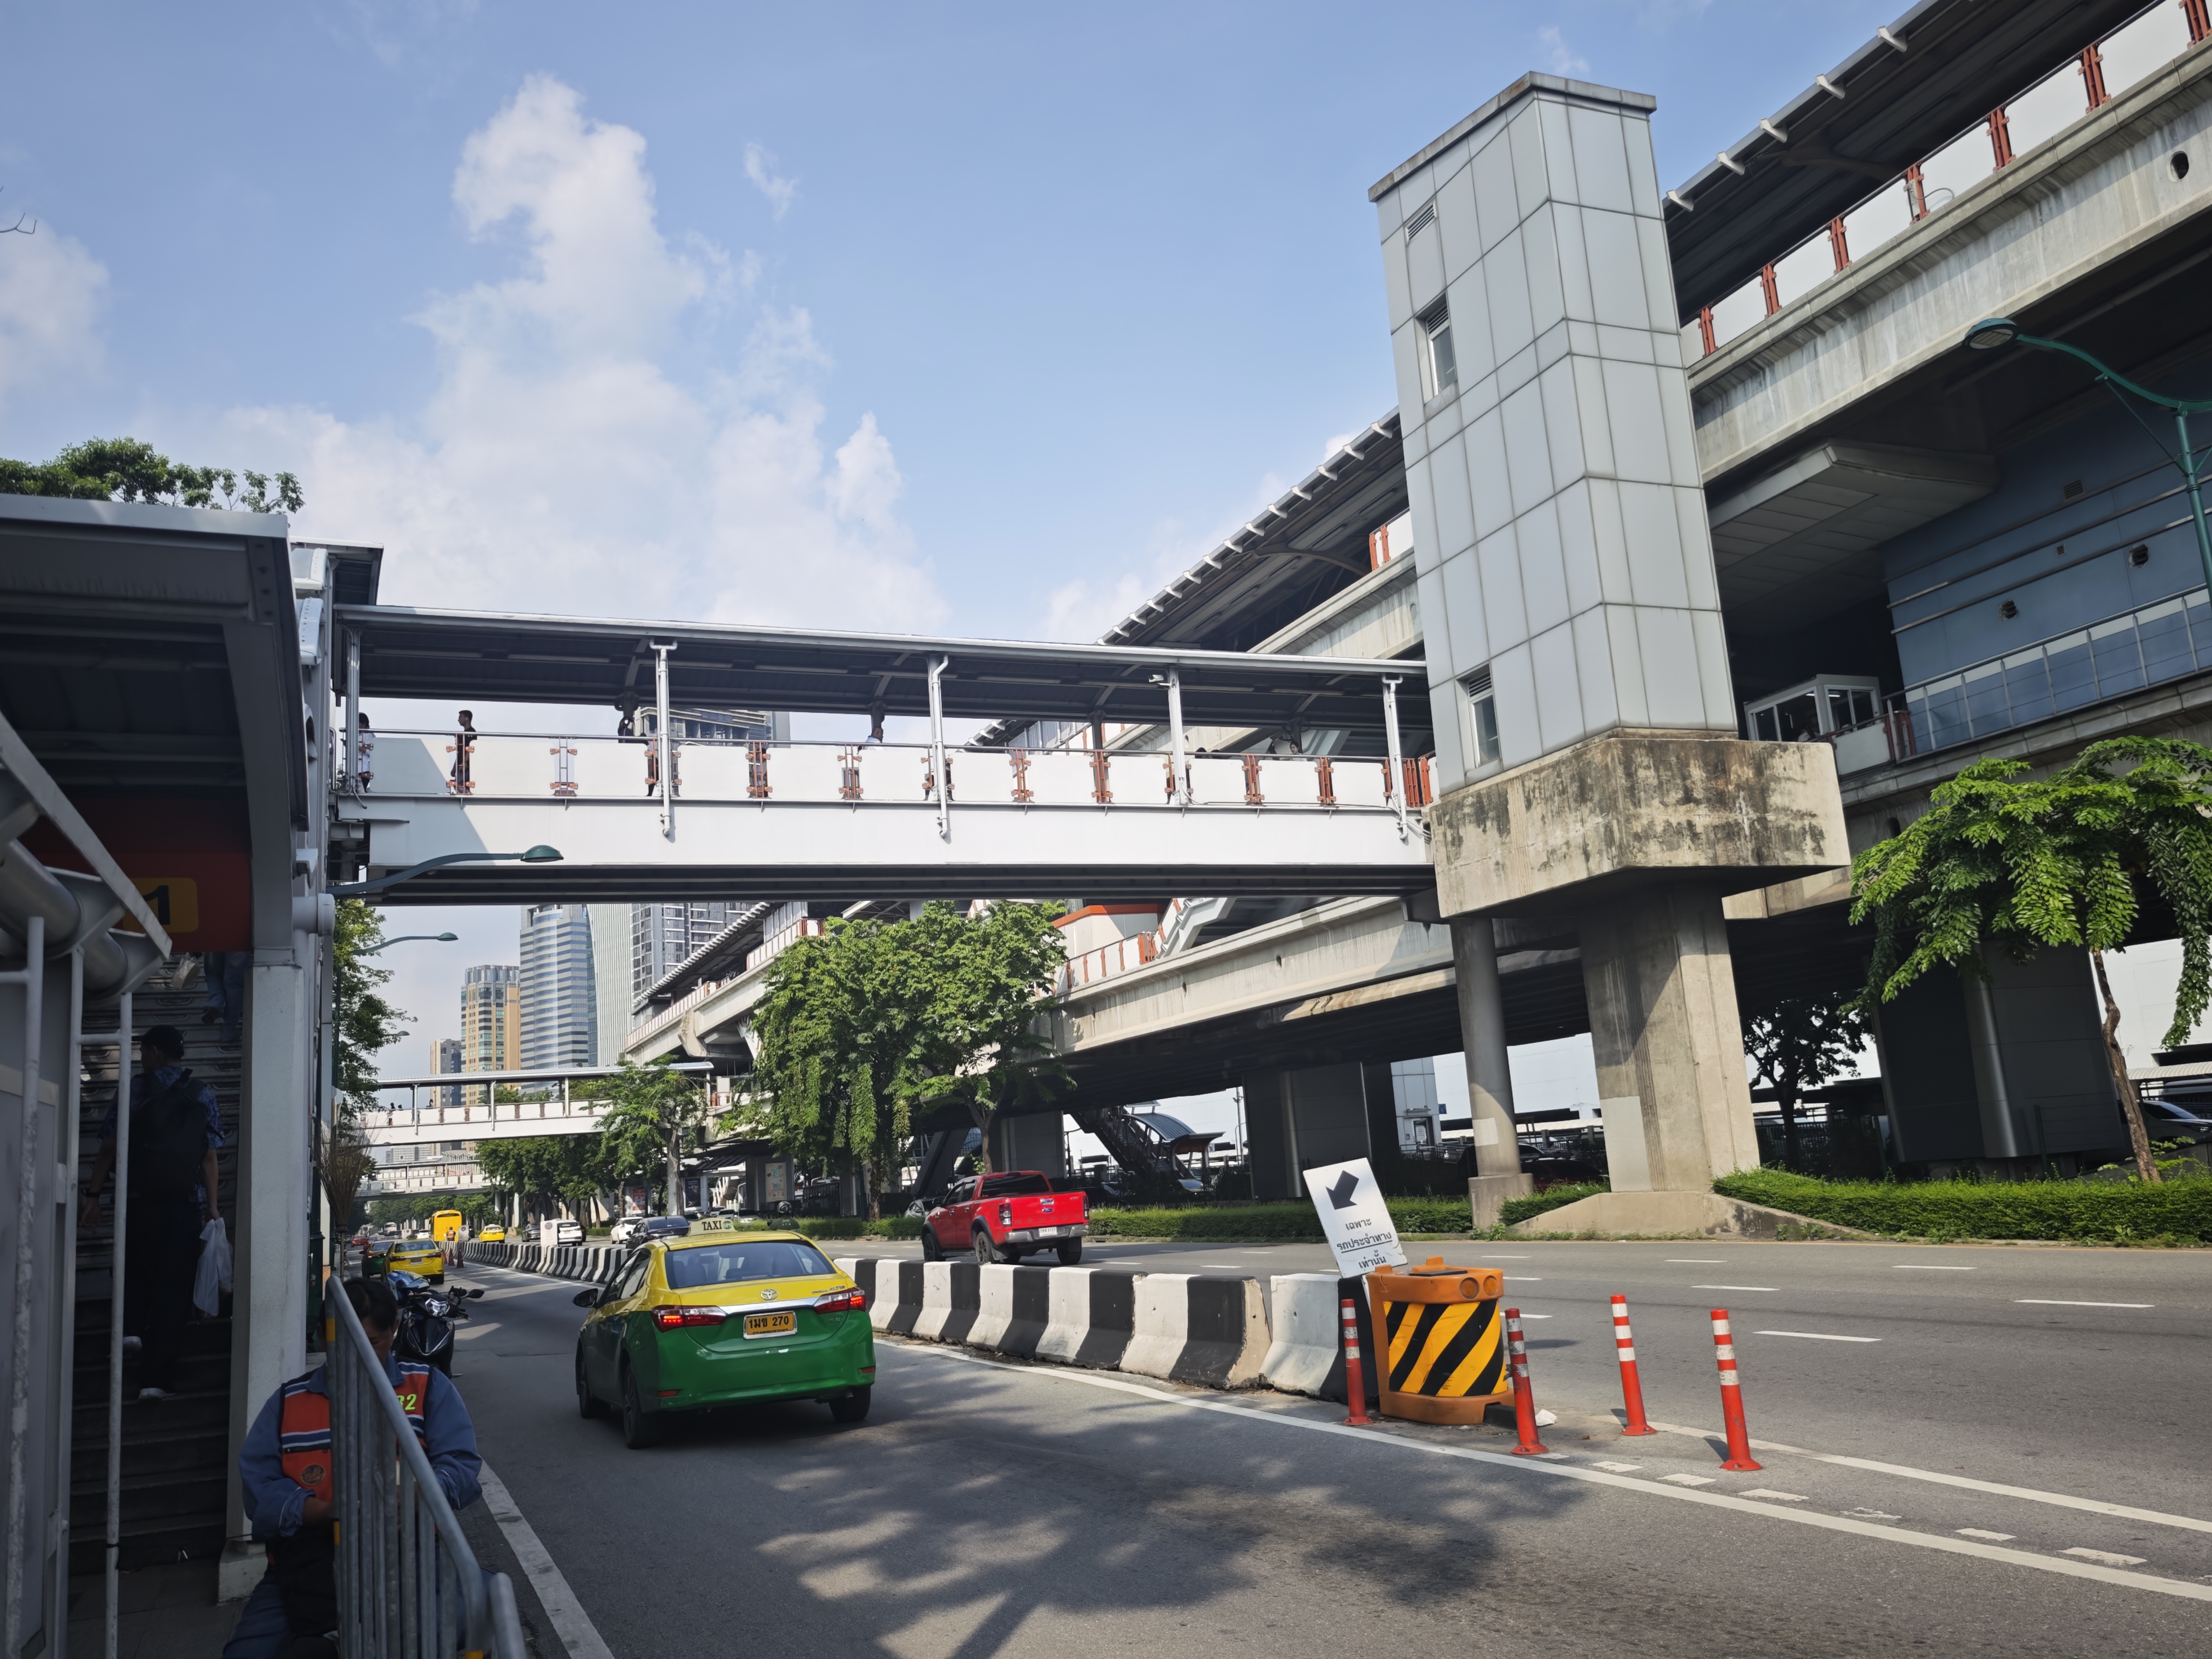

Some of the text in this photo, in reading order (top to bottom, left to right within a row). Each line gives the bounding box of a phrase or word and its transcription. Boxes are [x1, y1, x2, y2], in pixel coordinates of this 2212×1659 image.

[143, 885, 171, 925] 1
[702, 1220, 723, 1231] TAXI
[1345, 1218, 1372, 1230] เฉพาะ
[1337, 1232, 1392, 1250] รถประจำทาง
[1358, 1249, 1387, 1269] เท่านั้น
[748, 1316, 790, 1328] 1มข 270
